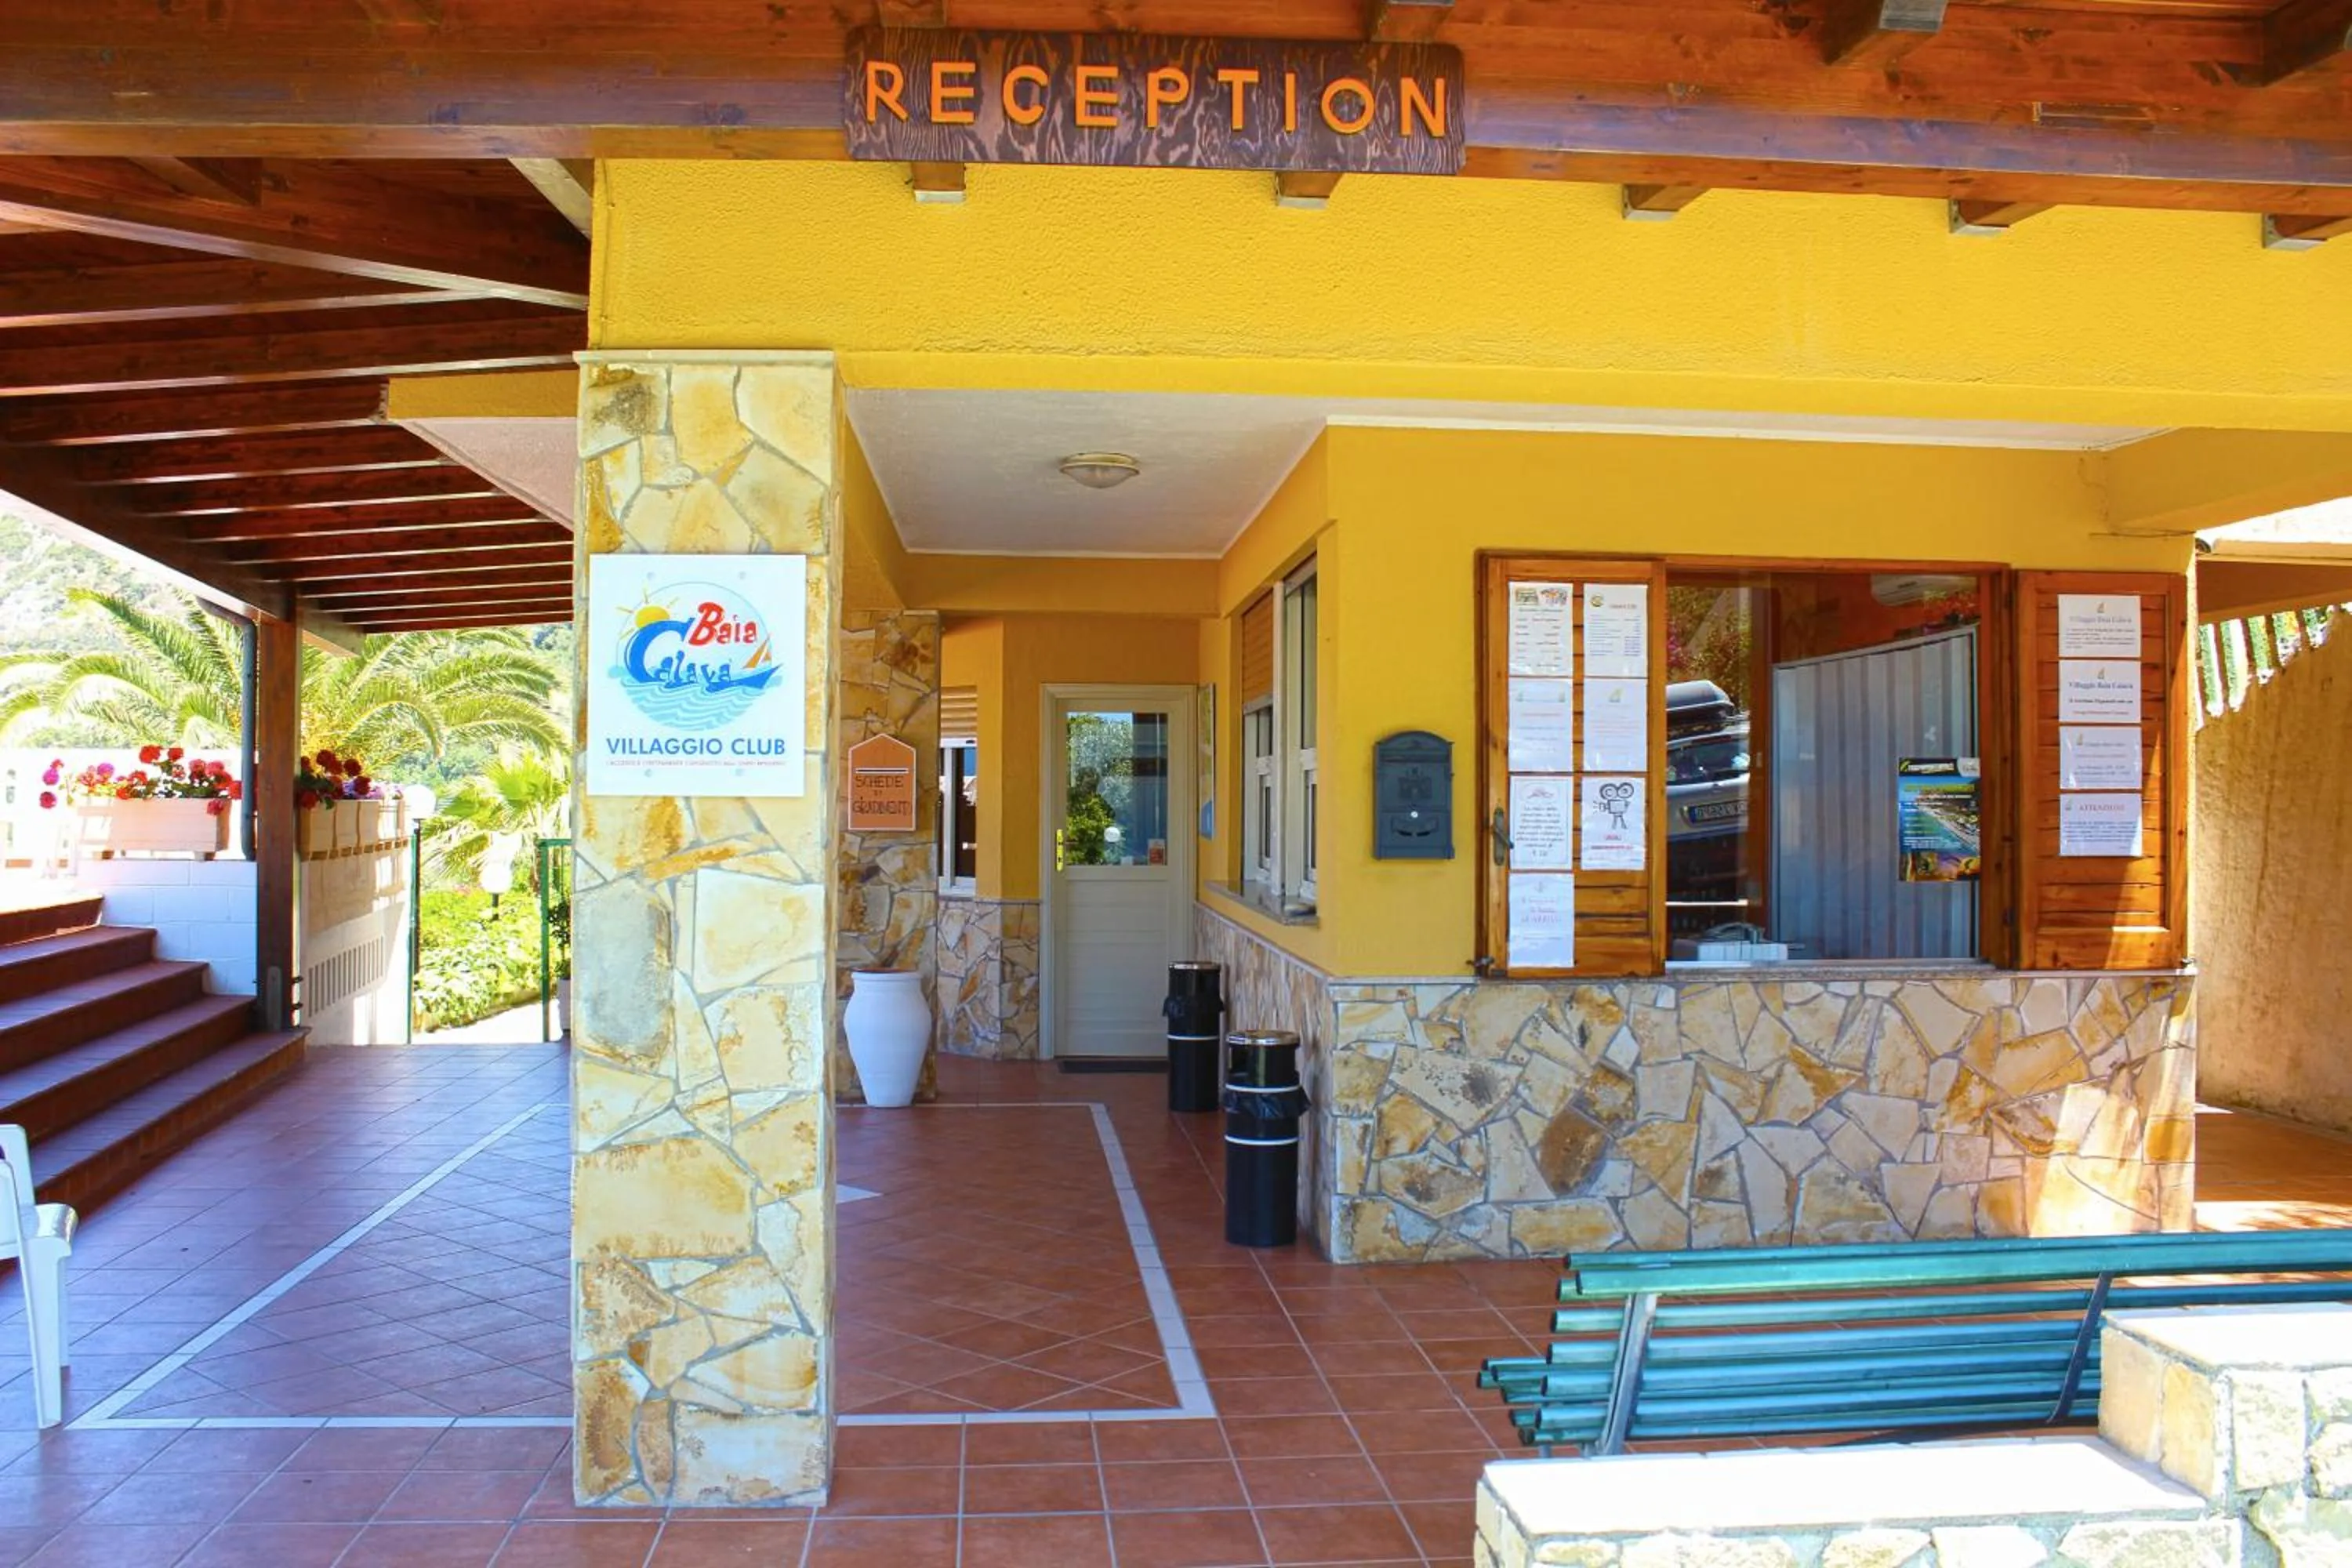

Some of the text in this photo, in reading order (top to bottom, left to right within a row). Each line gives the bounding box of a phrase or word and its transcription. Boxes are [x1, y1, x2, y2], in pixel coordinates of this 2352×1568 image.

[866, 60, 1446, 138] RECEPTION
[688, 601, 757, 647] Baia
[606, 737, 786, 756] VILLAGGIO CLUB
